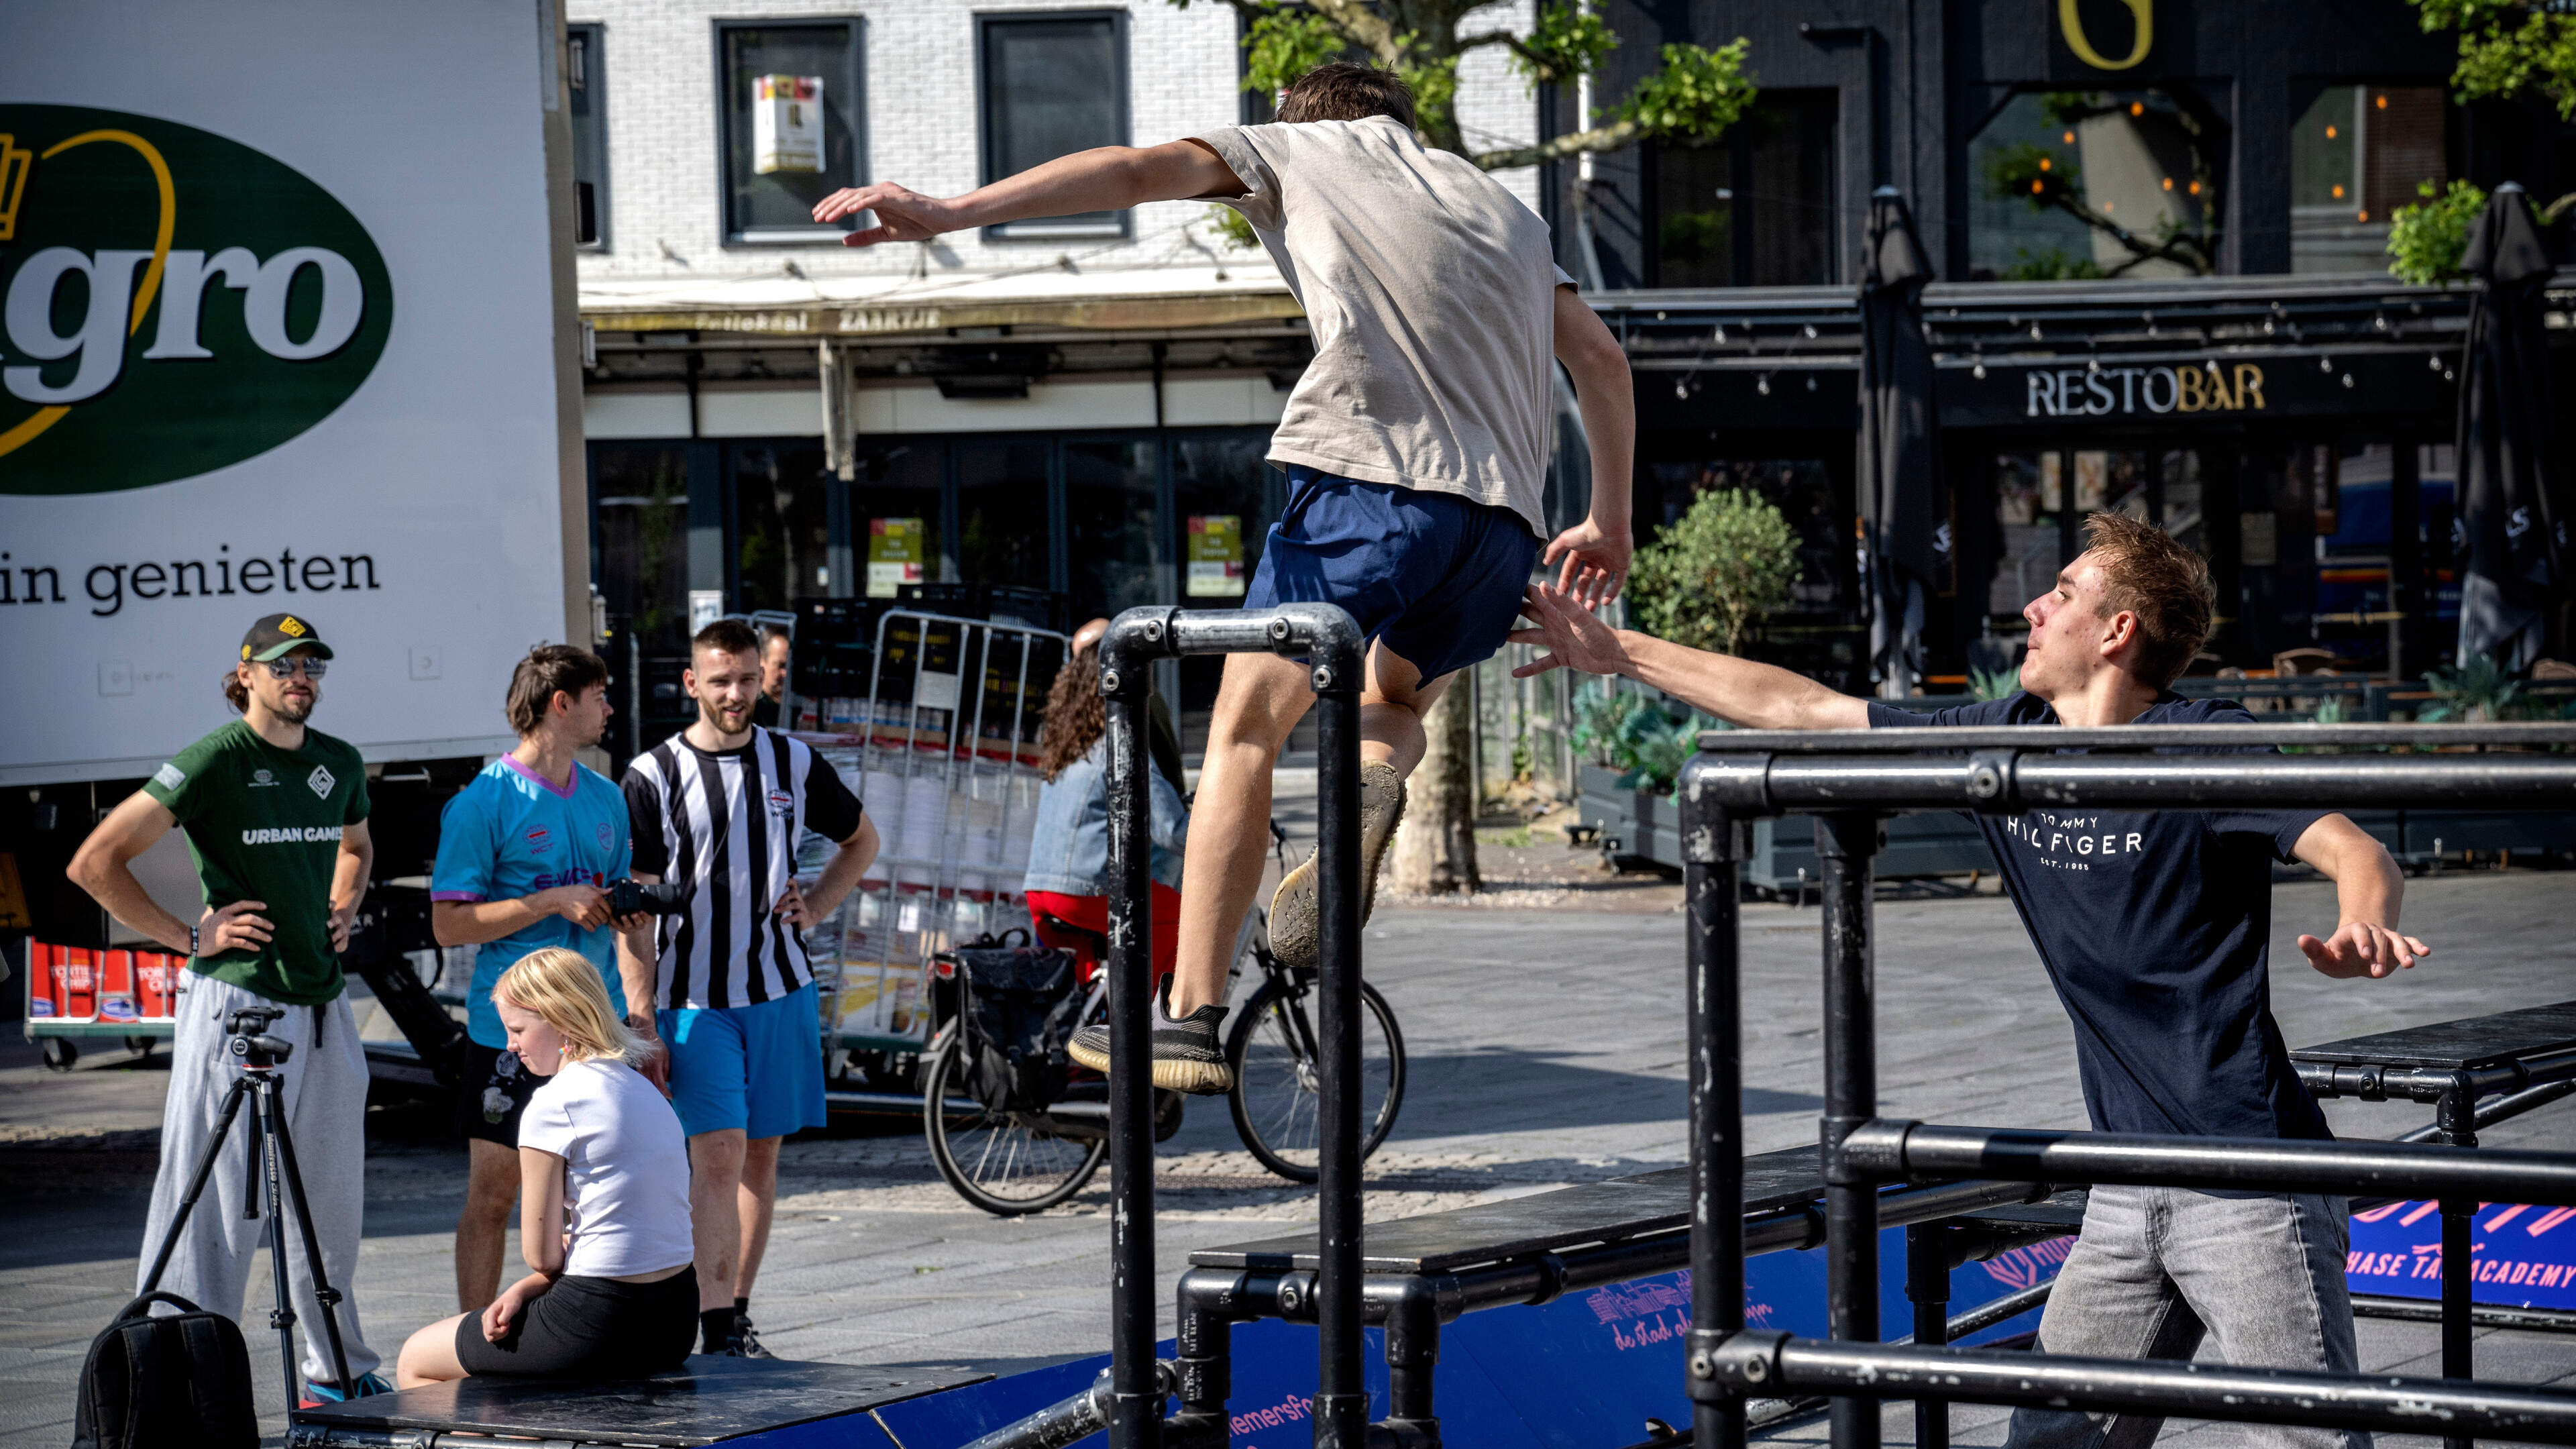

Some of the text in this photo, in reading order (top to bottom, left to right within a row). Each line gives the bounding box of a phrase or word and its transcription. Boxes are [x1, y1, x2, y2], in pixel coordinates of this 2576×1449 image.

[0, 246, 364, 402] gro
[2026, 363, 2265, 417] RESTOBAR
[85, 544, 380, 616] genieten
[242, 827, 301, 845] URBAN
[2008, 815, 2143, 855] HILFIGER
[2041, 813, 2098, 829] TOMMY
[2345, 1250, 2408, 1277] HASE
[2411, 1256, 2442, 1279] TA
[1613, 1324, 1635, 1351] de
[1634, 1313, 1673, 1346] stad
